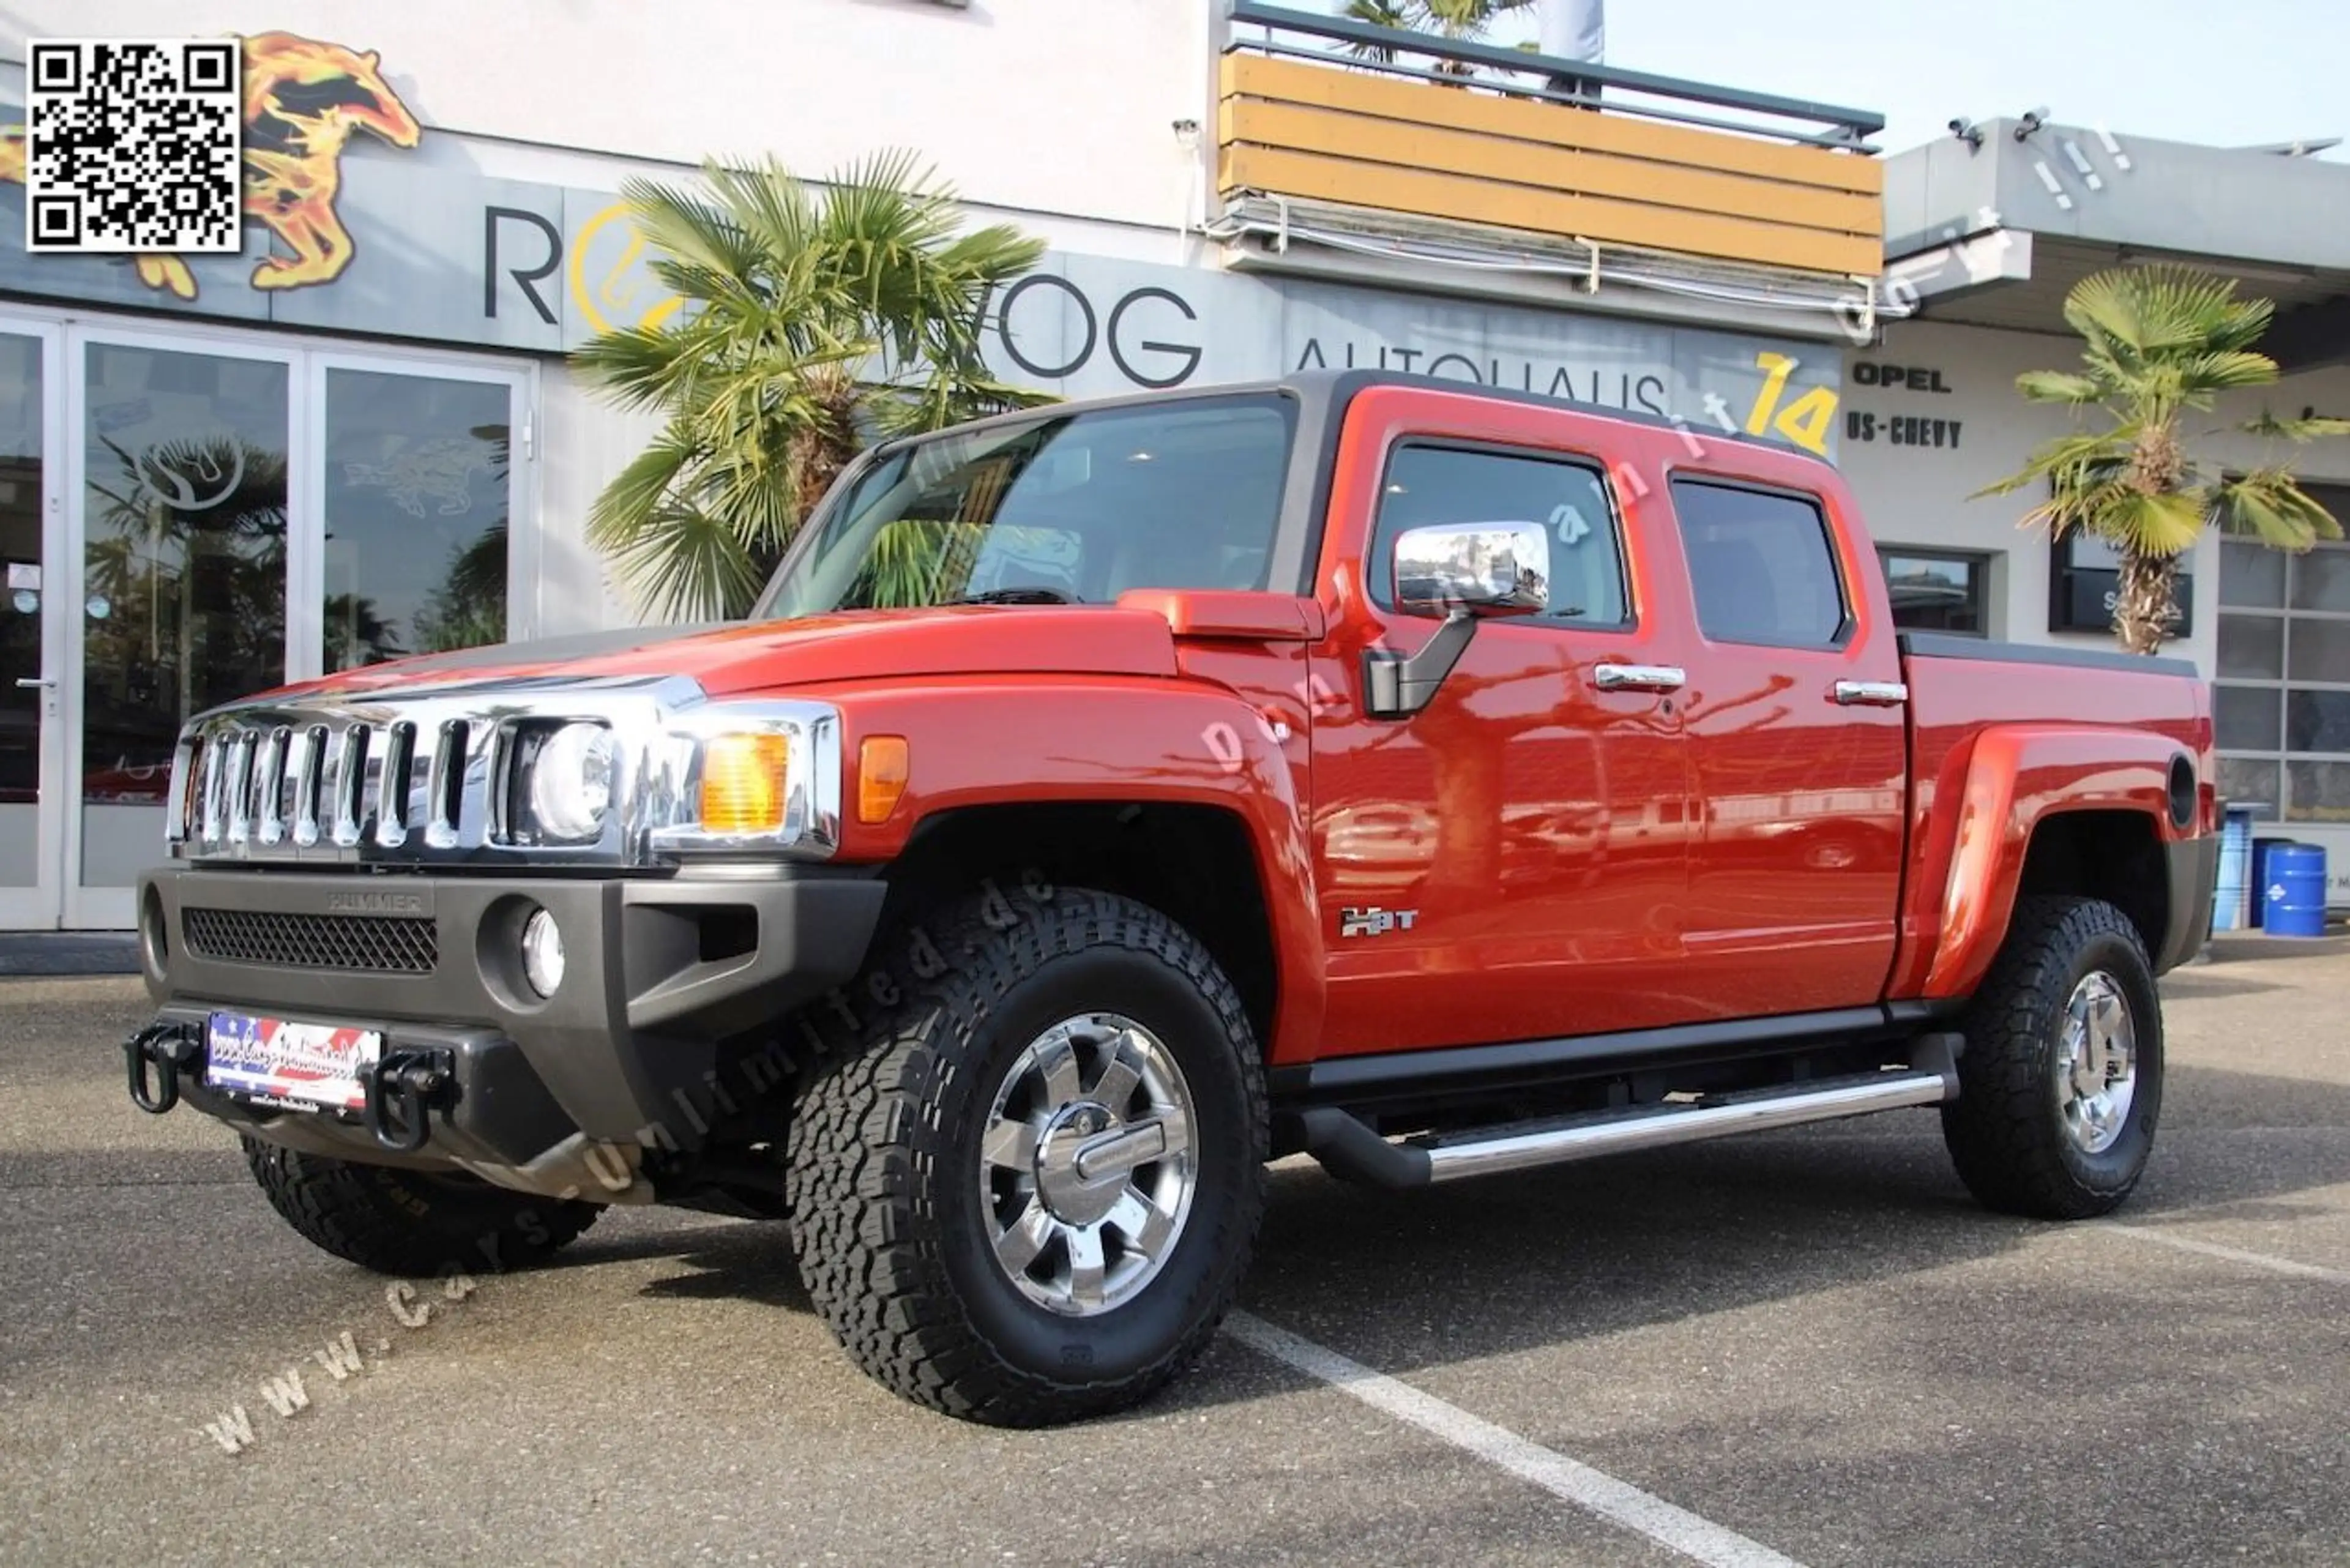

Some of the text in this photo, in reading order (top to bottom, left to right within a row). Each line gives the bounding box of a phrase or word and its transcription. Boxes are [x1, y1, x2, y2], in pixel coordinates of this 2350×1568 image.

[1852, 362, 1952, 394] OPEL
[1847, 411, 1962, 449] US-CHEVY
[328, 892, 422, 911] HUMMER
